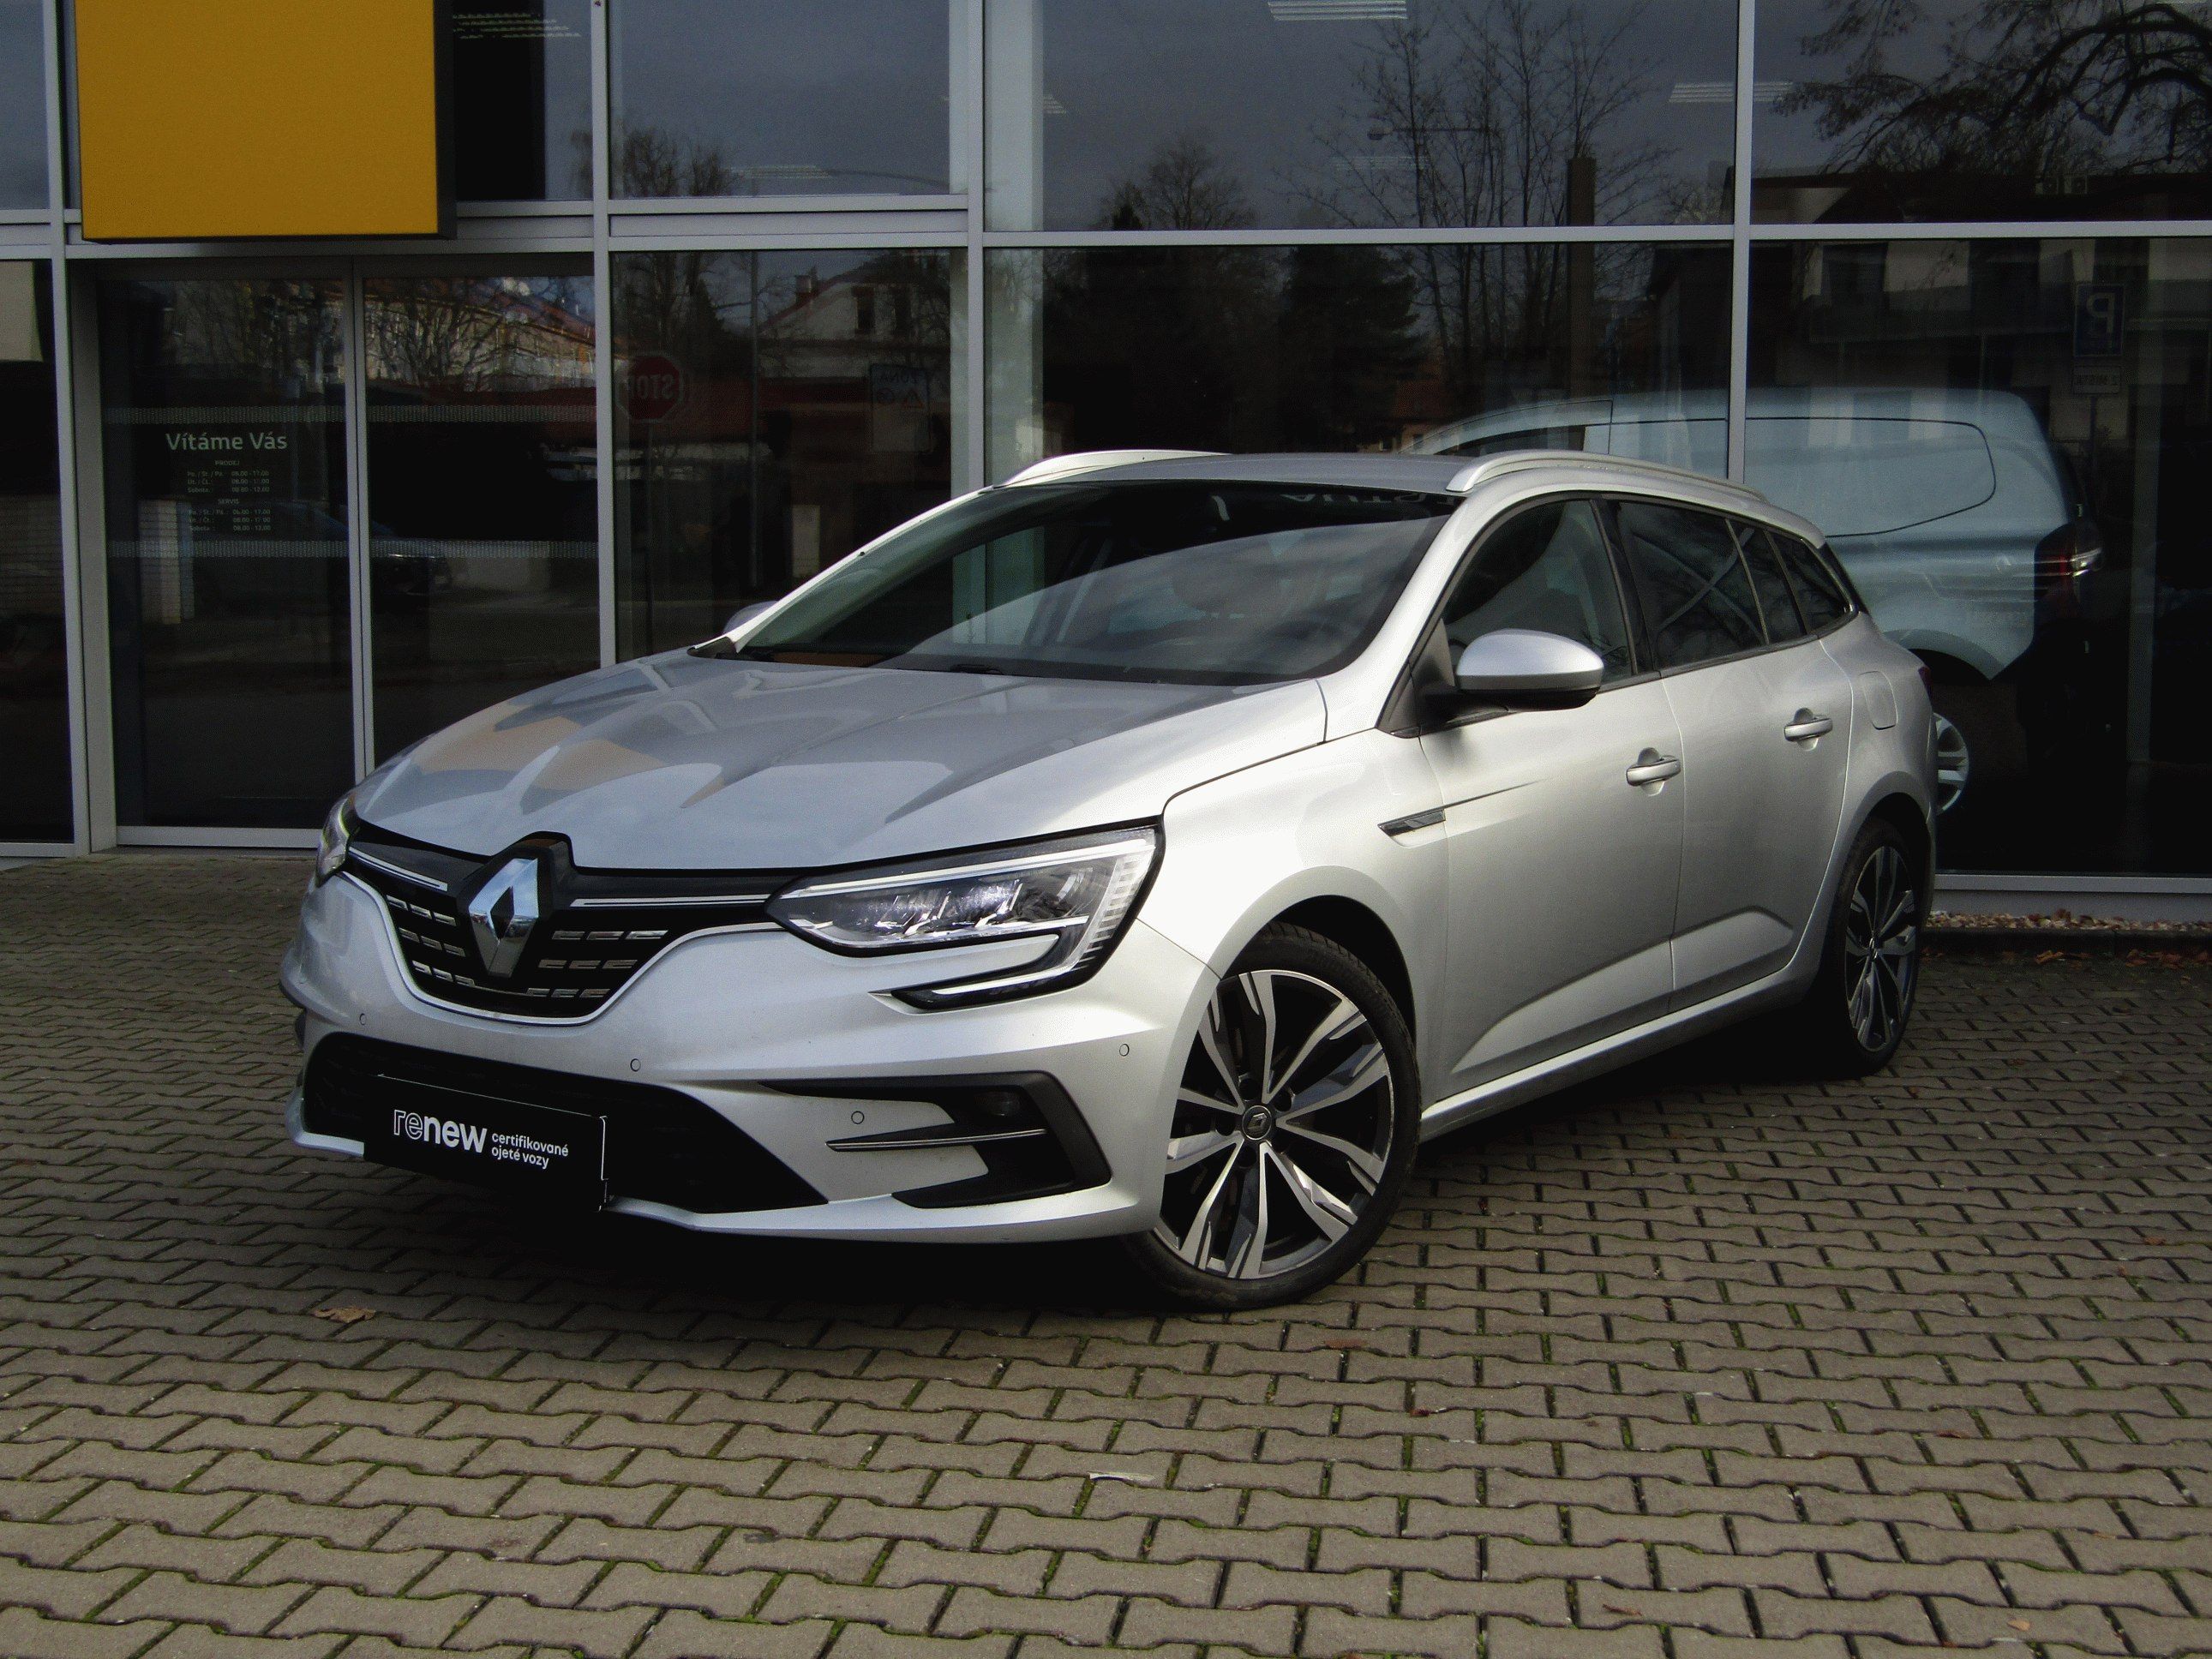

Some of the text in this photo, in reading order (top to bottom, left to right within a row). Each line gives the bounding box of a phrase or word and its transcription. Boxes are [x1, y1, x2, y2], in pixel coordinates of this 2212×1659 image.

[165, 431, 288, 451] Vítáme Vás
[393, 1109, 488, 1153] renew
[491, 1132, 569, 1157] certifikované
[491, 1145, 550, 1169] ojeté vozy
